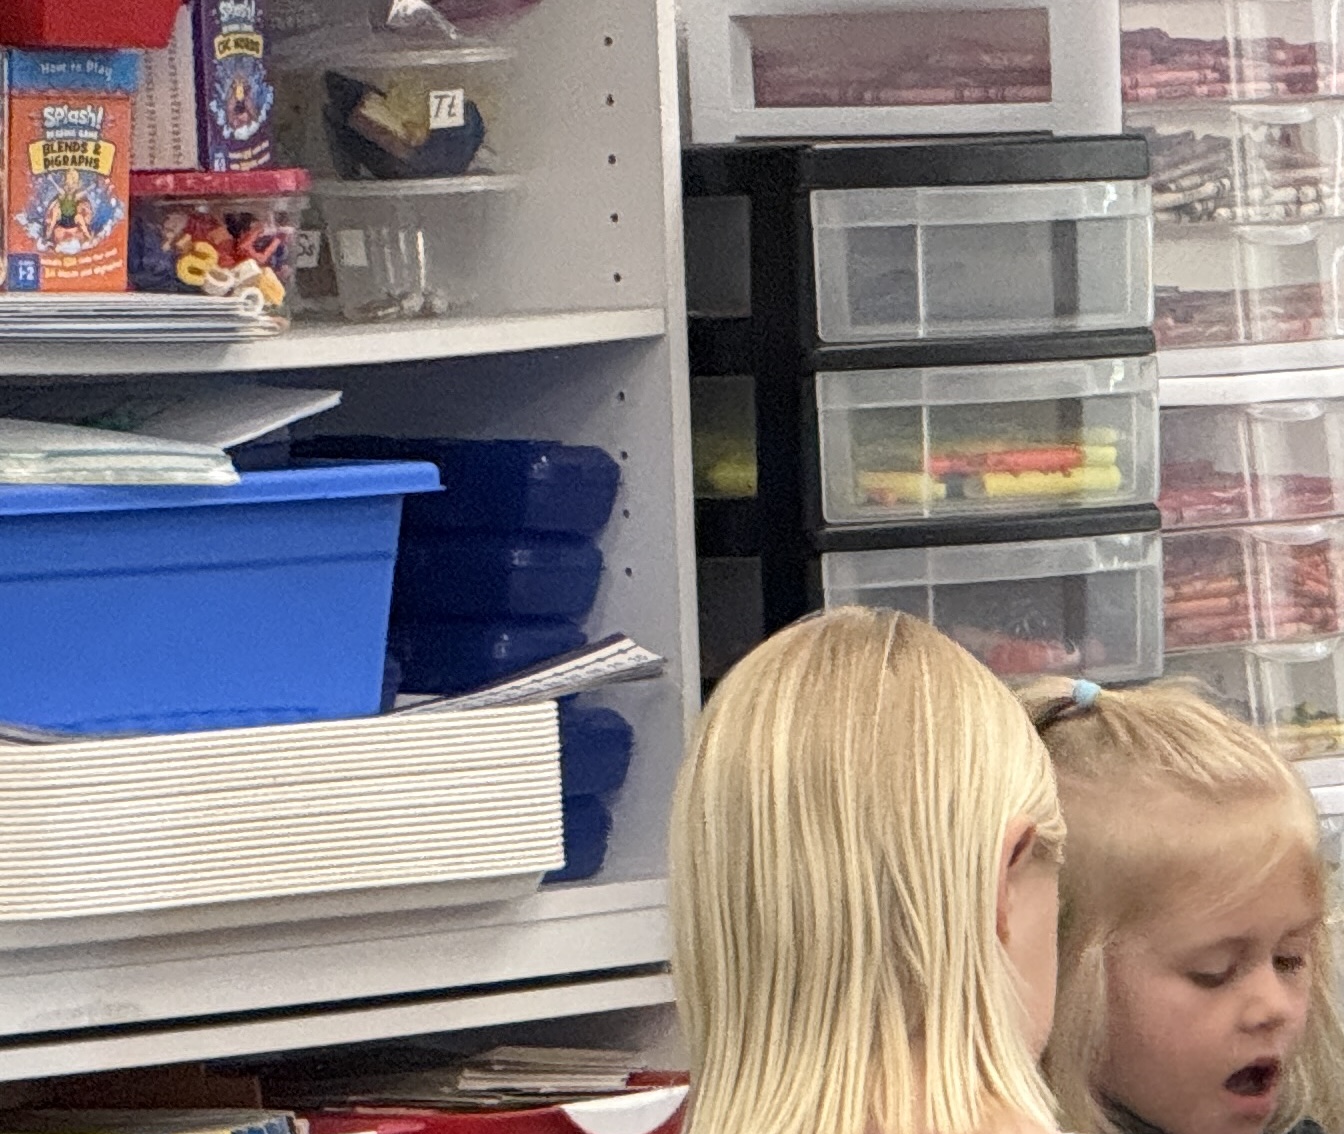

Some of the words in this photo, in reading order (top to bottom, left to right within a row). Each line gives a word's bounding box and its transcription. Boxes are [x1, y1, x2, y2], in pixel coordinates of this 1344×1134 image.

[86, 60, 112, 81] Play
[42, 141, 89, 156] BLENDS
[43, 154, 101, 170] DIGRAPHS
